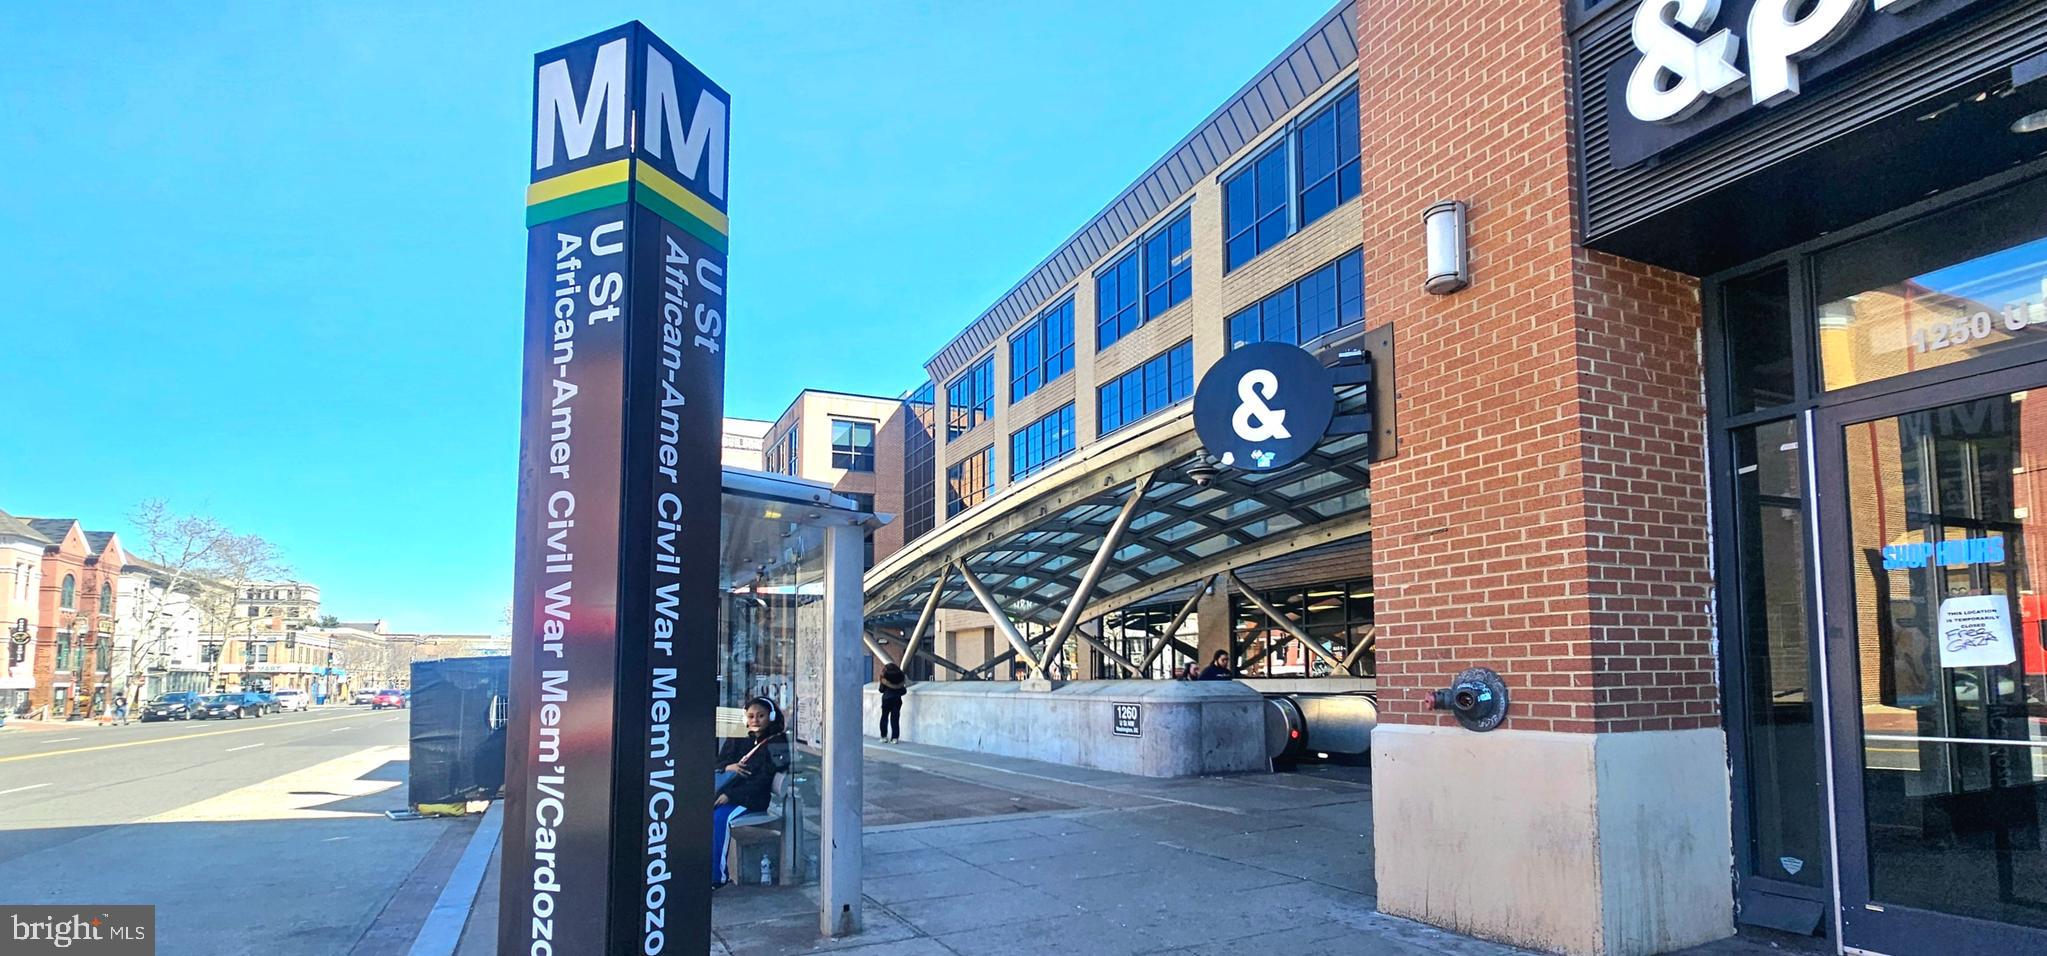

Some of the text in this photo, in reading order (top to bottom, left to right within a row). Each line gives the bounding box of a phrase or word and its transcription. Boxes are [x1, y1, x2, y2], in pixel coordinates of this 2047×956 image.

[1626, 0, 1912, 122] &p
[536, 37, 627, 171] M
[644, 43, 726, 201] M
[588, 221, 624, 325] U St
[693, 256, 723, 354] U St
[550, 232, 582, 480] African-Amer
[658, 235, 690, 484] African-Amer
[1911, 311, 1992, 354] 1250
[2003, 300, 2030, 331] U
[1231, 368, 1292, 442] &
[545, 490, 576, 574] Civil
[655, 492, 683, 574] Civil
[1882, 536, 2005, 570] SHOP HOURS
[543, 581, 572, 659] War
[653, 582, 680, 657] War
[1963, 608, 1997, 616] LOCATION
[1117, 706, 1137, 720] 1260
